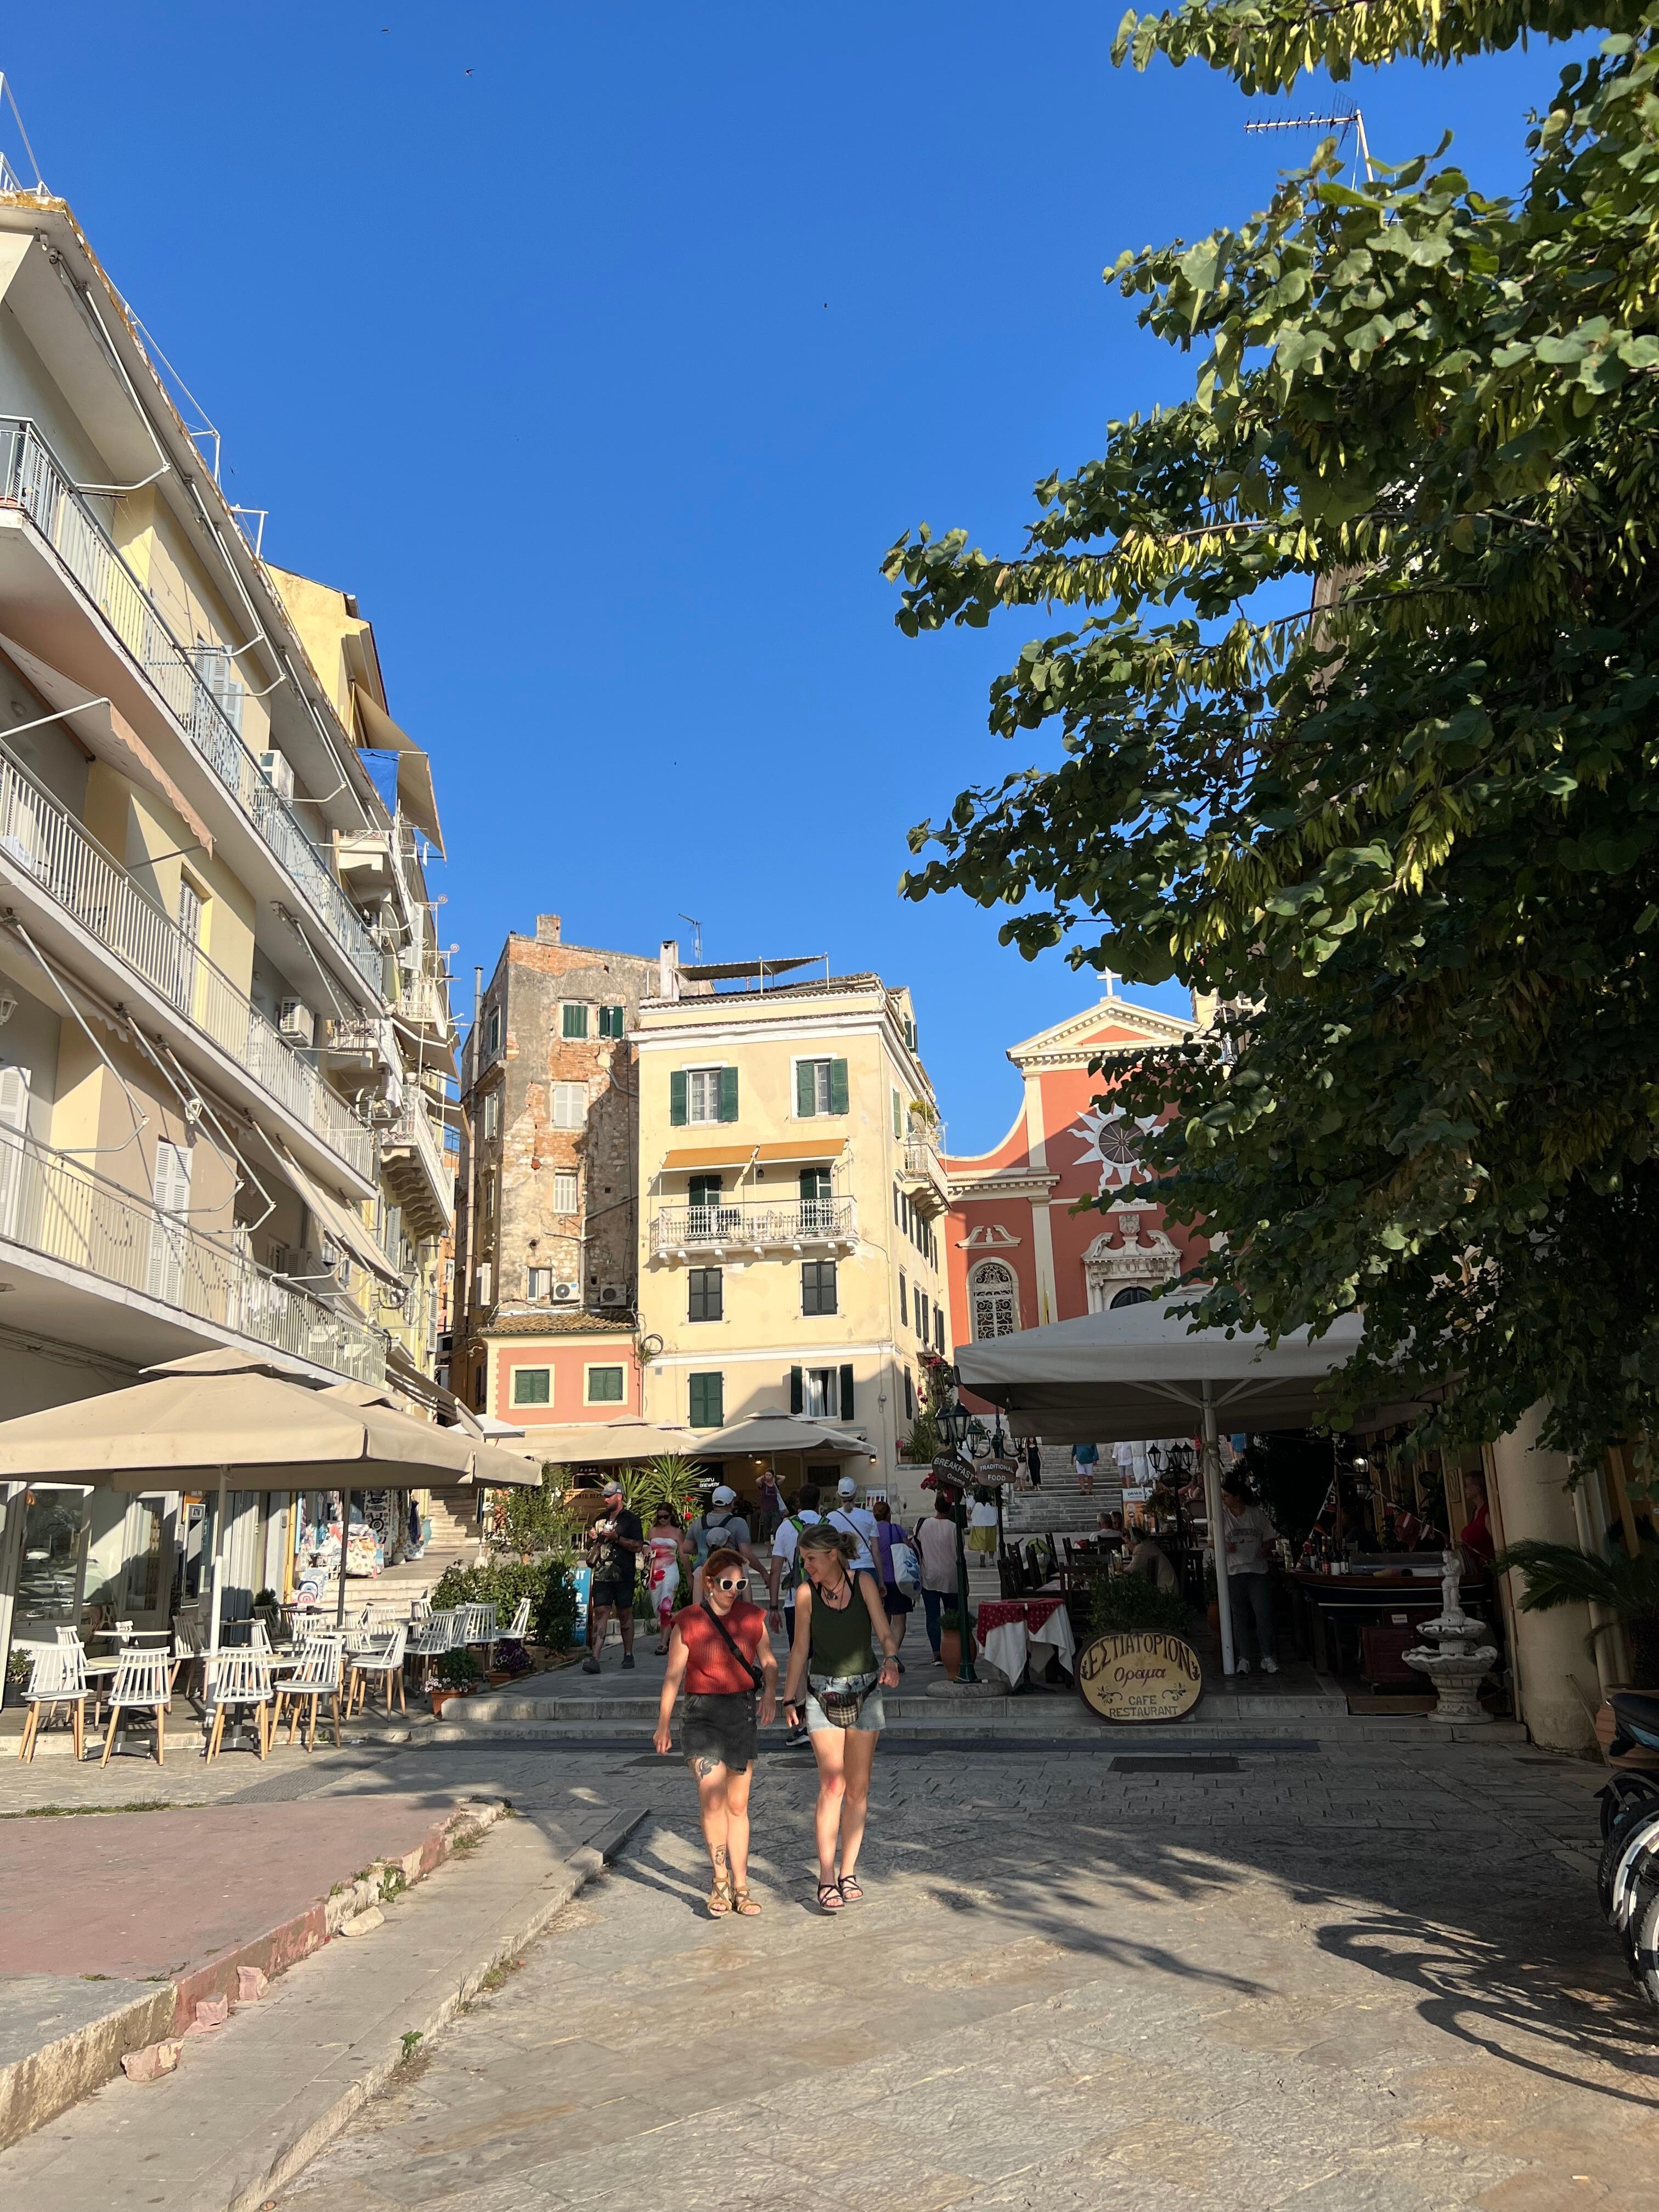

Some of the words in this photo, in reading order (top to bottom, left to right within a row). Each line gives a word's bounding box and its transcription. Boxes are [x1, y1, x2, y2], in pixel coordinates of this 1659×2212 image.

[933, 1457, 974, 1481] BREAKFAST
[980, 1464, 1014, 1474] TRADITIONAL
[947, 1473, 966, 1486] Orama
[1128, 1695, 1157, 1705] CAFE
[1109, 1706, 1178, 1717] RESTAURANT
